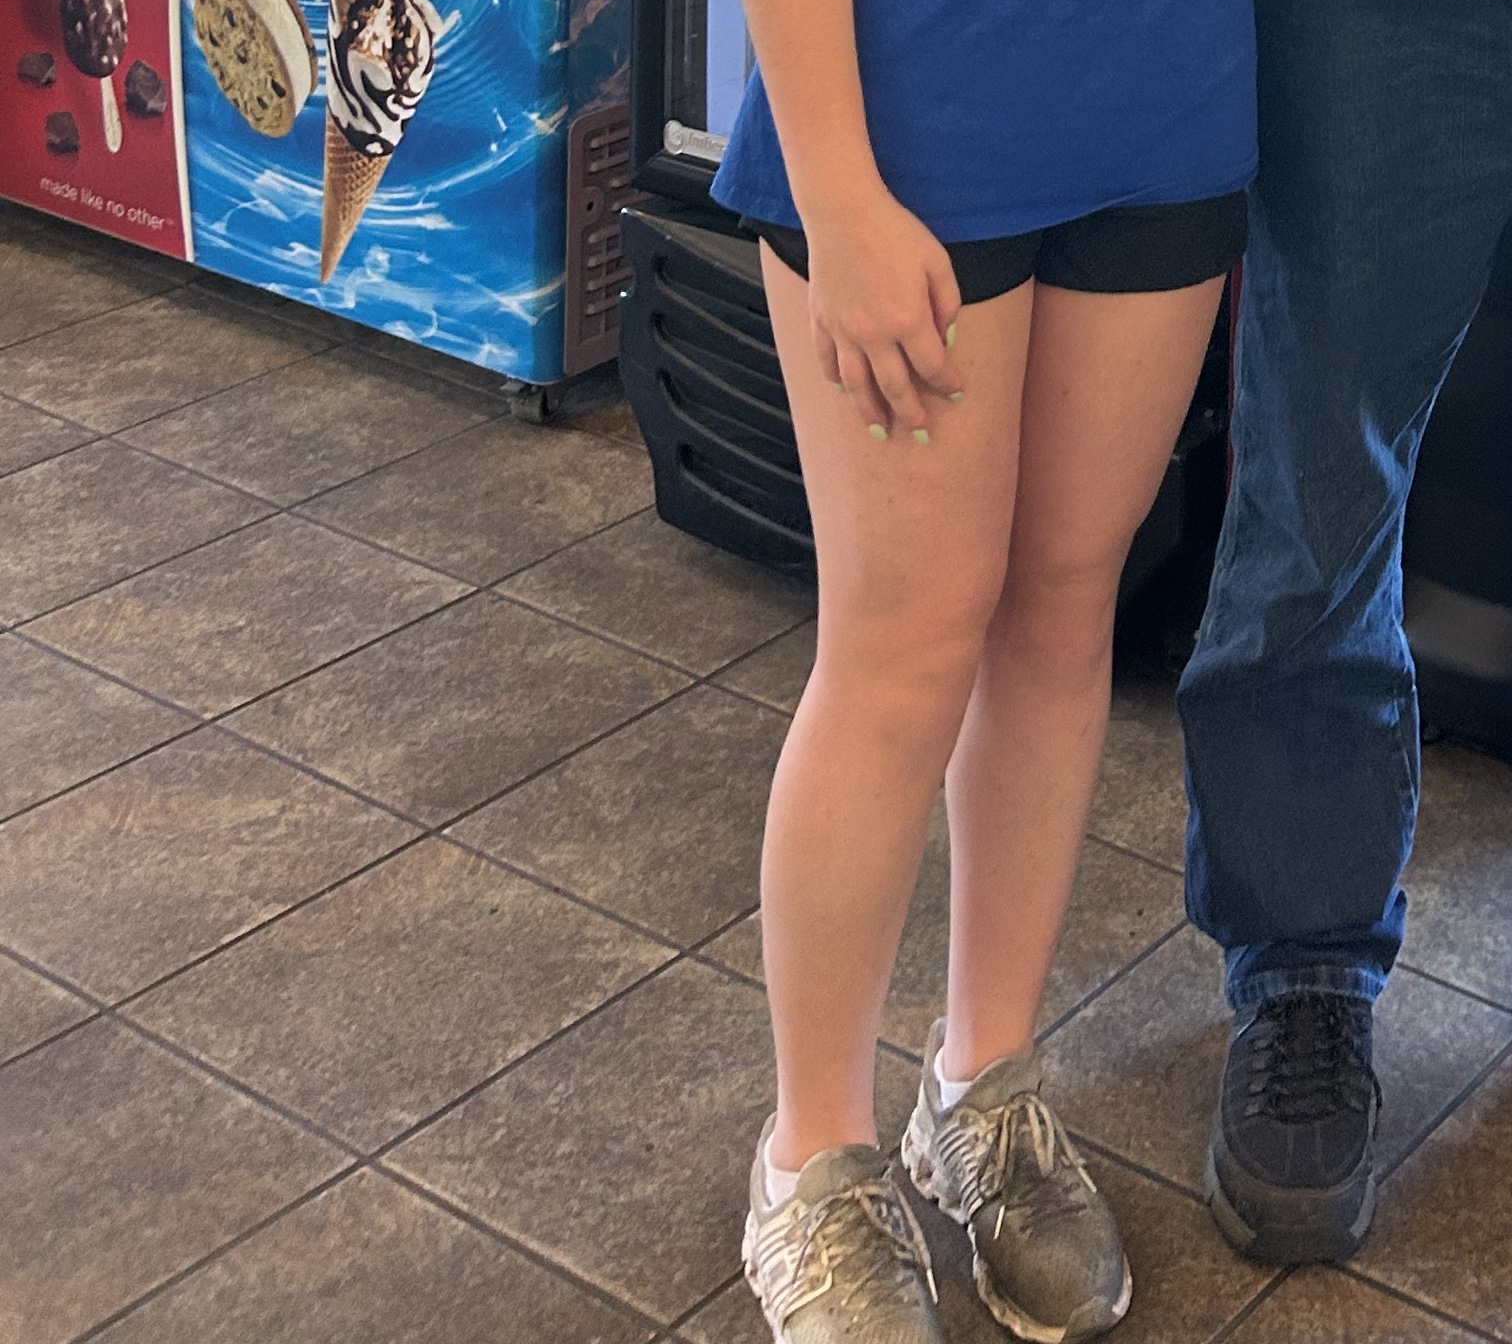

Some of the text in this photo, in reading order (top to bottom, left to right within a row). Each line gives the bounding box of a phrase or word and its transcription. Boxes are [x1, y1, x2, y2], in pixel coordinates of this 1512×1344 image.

[40, 176, 165, 232] made like no other
